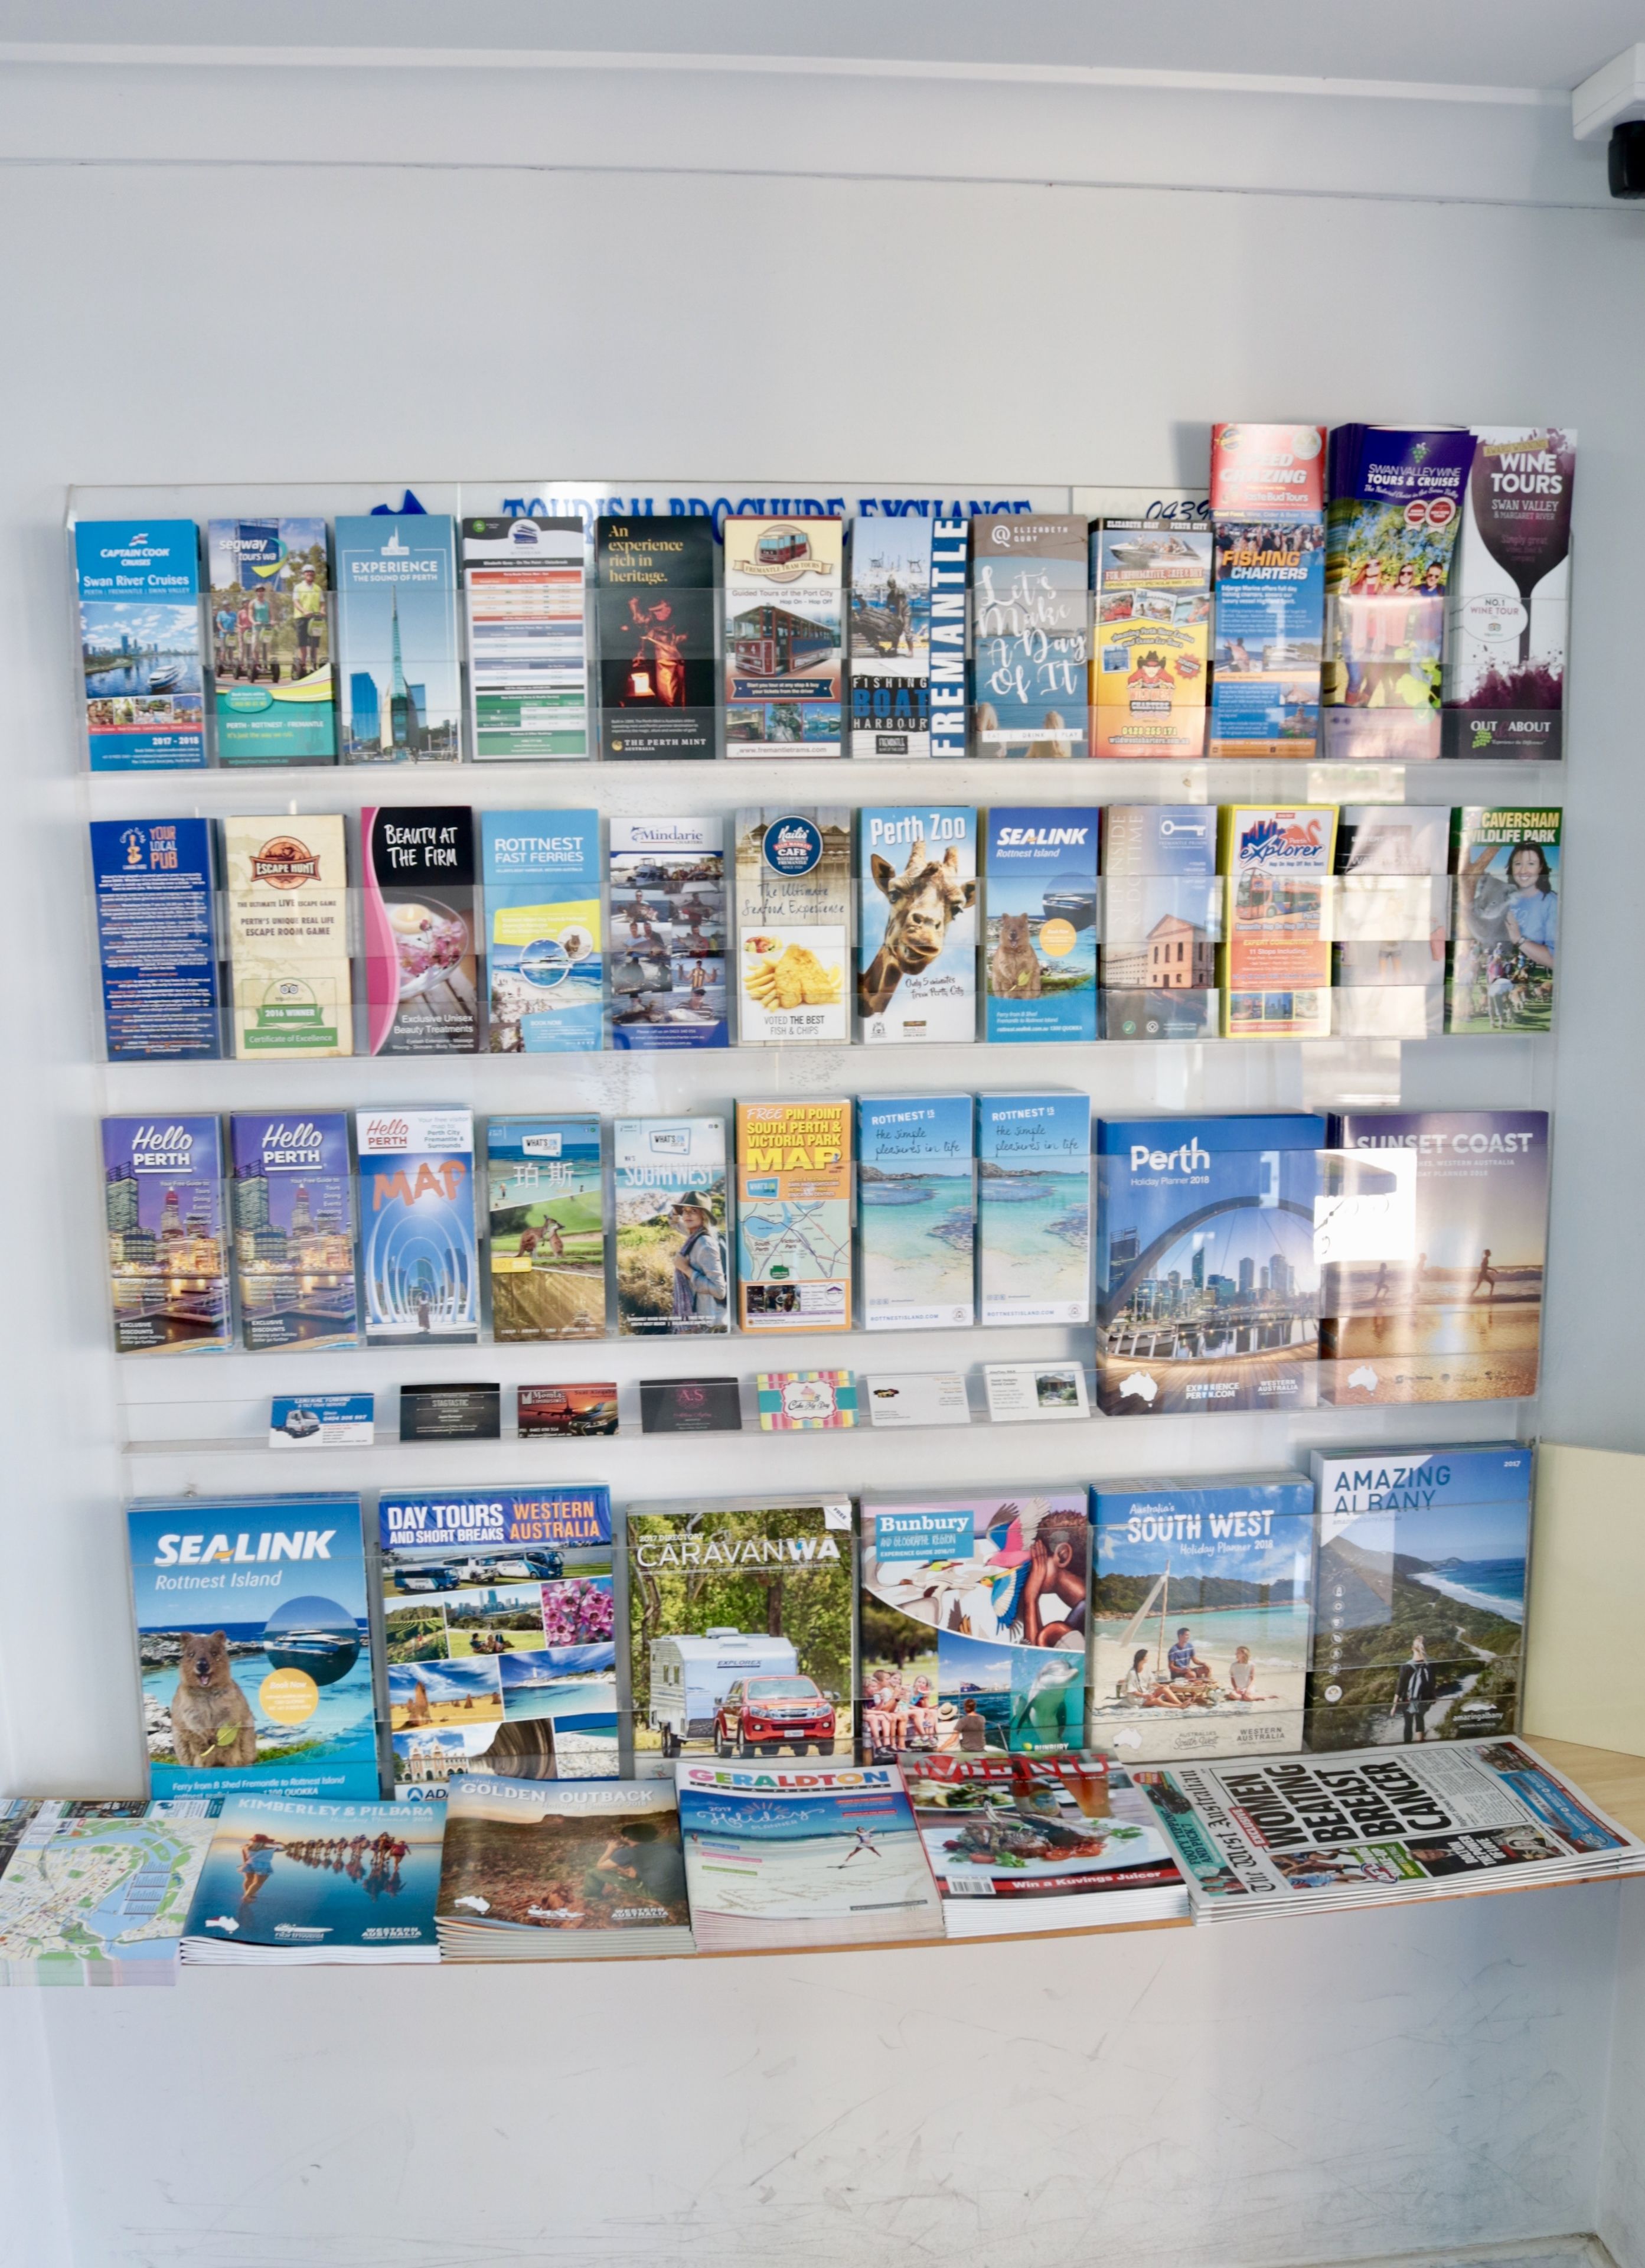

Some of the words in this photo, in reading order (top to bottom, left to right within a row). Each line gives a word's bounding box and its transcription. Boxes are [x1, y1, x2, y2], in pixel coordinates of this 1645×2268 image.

[1500, 453, 1556, 472] WINE
[1369, 464, 1399, 474] SWAN
[1400, 466, 1436, 477] VALLEY
[1437, 467, 1461, 477] WINE
[1367, 474, 1404, 485] TOURS
[1406, 477, 1414, 486] &
[1417, 477, 1460, 487] CRUISES
[1491, 473, 1563, 494] TOURS
[1491, 500, 1519, 511] SWAN
[1522, 501, 1559, 512] VALLEY
[609, 524, 629, 537] An
[219, 538, 267, 552] segway
[608, 539, 683, 554] experience
[100, 549, 141, 558] CAPTAIN
[142, 548, 170, 556] COOK
[238, 551, 262, 561] tours
[609, 554, 635, 566] rich
[638, 554, 652, 566] in
[1222, 550, 1301, 567] FISHING
[352, 561, 438, 573] EXPERIENCE
[1231, 567, 1308, 580] CHARTERS
[83, 575, 113, 586] Swan
[116, 575, 145, 586] River
[148, 574, 190, 585] Cruises
[609, 569, 668, 585] heritage.
[819, 589, 833, 598] City
[1484, 598, 1506, 607] NO.1
[1470, 607, 1494, 615] WINE
[1496, 607, 1519, 615] TOUR
[931, 520, 969, 757] FREMANTLE
[853, 677, 928, 689] FISHING
[853, 689, 929, 718] BOAT
[853, 718, 928, 731] HARBOUR
[1470, 721, 1497, 732] OUT
[1508, 721, 1551, 732] ABOUT
[648, 738, 677, 747] PERTH
[681, 738, 707, 746] MINT
[1481, 812, 1560, 829] CAVERSHAM
[149, 826, 177, 841] YOUR
[384, 824, 437, 845] BEAUTY
[439, 826, 458, 844] AT
[641, 826, 703, 841] Mindarie
[870, 815, 924, 846] Perth
[929, 813, 966, 841] Zoo
[997, 827, 1090, 846] SEALINK
[1468, 829, 1520, 843] WILDLIFE
[1523, 830, 1556, 843] PARK
[149, 841, 178, 851] LOCAL
[494, 836, 584, 852] ROTTNEST
[150, 851, 178, 870] PUB
[387, 846, 417, 868] THE
[425, 846, 458, 866] FIRM
[495, 852, 526, 863] FAST
[530, 852, 585, 863] FERRIES
[996, 849, 1032, 858] Rottnest
[1033, 848, 1061, 858] Island
[256, 862, 289, 875] ESCAPE
[291, 861, 315, 875] HUNT
[241, 917, 270, 926] PERTH'S
[272, 917, 299, 926] UNIQUE
[301, 917, 319, 926] REAL
[321, 917, 335, 925] LIFE
[246, 927, 275, 937] ESCAPE
[277, 927, 304, 937] ROOM
[306, 927, 331, 936] GAME
[265, 1009, 285, 1018] 2016
[286, 1008, 315, 1018] WINNER
[402, 1014, 442, 1024] Exclusive
[444, 1014, 474, 1023] Unisex
[763, 1016, 788, 1025] VOTED
[790, 1016, 805, 1025] THE
[805, 1015, 825, 1025] BEST
[394, 1025, 424, 1036] Beauty
[426, 1025, 474, 1034] Treatments
[770, 1027, 787, 1035] FISH
[788, 1027, 795, 1035] &
[796, 1027, 819, 1035] CHIPS
[249, 1034, 285, 1044] Certificate
[286, 1034, 295, 1043] of
[295, 1033, 333, 1043] Excellence
[746, 1109, 784, 1120] FREE
[785, 1109, 807, 1120] PIN
[808, 1108, 842, 1120] POINT
[871, 1110, 926, 1125] ROTTNEST
[927, 1109, 936, 1118] IS
[989, 1107, 1046, 1122] ROTTNEST
[1046, 1106, 1056, 1116] IS
[367, 1118, 409, 1136] Hello
[746, 1122, 787, 1135] SOUTH
[789, 1121, 830, 1133] PERTH
[832, 1120, 843, 1133] &
[132, 1125, 193, 1151] Hello
[261, 1122, 323, 1148] Hello
[367, 1137, 408, 1146] PERTH
[746, 1134, 804, 1148] VICTORIA
[807, 1133, 841, 1147] PARK
[1357, 1133, 1447, 1154] SUNSET
[1451, 1132, 1533, 1153] COAST
[133, 1152, 191, 1166] PERTH
[263, 1149, 321, 1164] PERTH
[746, 1146, 843, 1172] MAP
[1131, 1136, 1210, 1174] Perth
[625, 1165, 671, 1187] SOUTH
[674, 1164, 714, 1186] WEST
[1131, 1178, 1160, 1188] Holiday
[1161, 1177, 1189, 1185] Planner
[1190, 1175, 1210, 1185] 2018
[372, 1159, 467, 1212] MAP
[870, 1314, 939, 1322] ROTTNESTISLAND.COM
[987, 1309, 1055, 1318] ROTTNESTISLAND.COM
[1334, 1465, 1451, 1493] AMAZING
[513, 1501, 594, 1520] WESTERN
[1129, 1503, 1176, 1515] Australia's
[1334, 1490, 1436, 1517] ALBANY
[387, 1506, 427, 1530] DAY
[432, 1503, 504, 1529] TOURS
[833, 1507, 847, 1521] FREE
[510, 1520, 600, 1540] AUSTRALIA
[879, 1517, 969, 1533] Bunbury
[1128, 1514, 1201, 1543] SOUTH
[1209, 1510, 1275, 1539] WEST
[389, 1531, 414, 1545] AND
[415, 1530, 455, 1544] SHORT
[457, 1527, 504, 1542] BREAKS
[153, 1530, 337, 1566] SEALINK
[637, 1536, 841, 1568] CARAVANWA
[1180, 1543, 1215, 1557] Holiday
[1217, 1542, 1252, 1553] Planner
[1254, 1539, 1274, 1550] 2018
[155, 1573, 226, 1591] Rottnest
[230, 1569, 283, 1588] Island
[688, 1768, 890, 1788] GERALDTON
[461, 1783, 547, 1802] GOLDEN
[560, 1790, 653, 1803] OUTBACK
[1179, 1770, 1232, 1829] Australian
[1359, 1761, 1452, 1831] CANCER
[238, 1798, 338, 1816] KIMBERLEY
[343, 1806, 356, 1816] &
[359, 1806, 434, 1817] PILBARA
[1263, 1764, 1359, 1843] BEATING
[1313, 1770, 1408, 1837] BREAST
[1220, 1774, 1310, 1849] WOMEN
[1214, 1832, 1256, 1869] West
[1013, 1880, 1040, 1889] Win
[1056, 1875, 1113, 1886] Kuvings
[1116, 1871, 1161, 1881] Juicer
